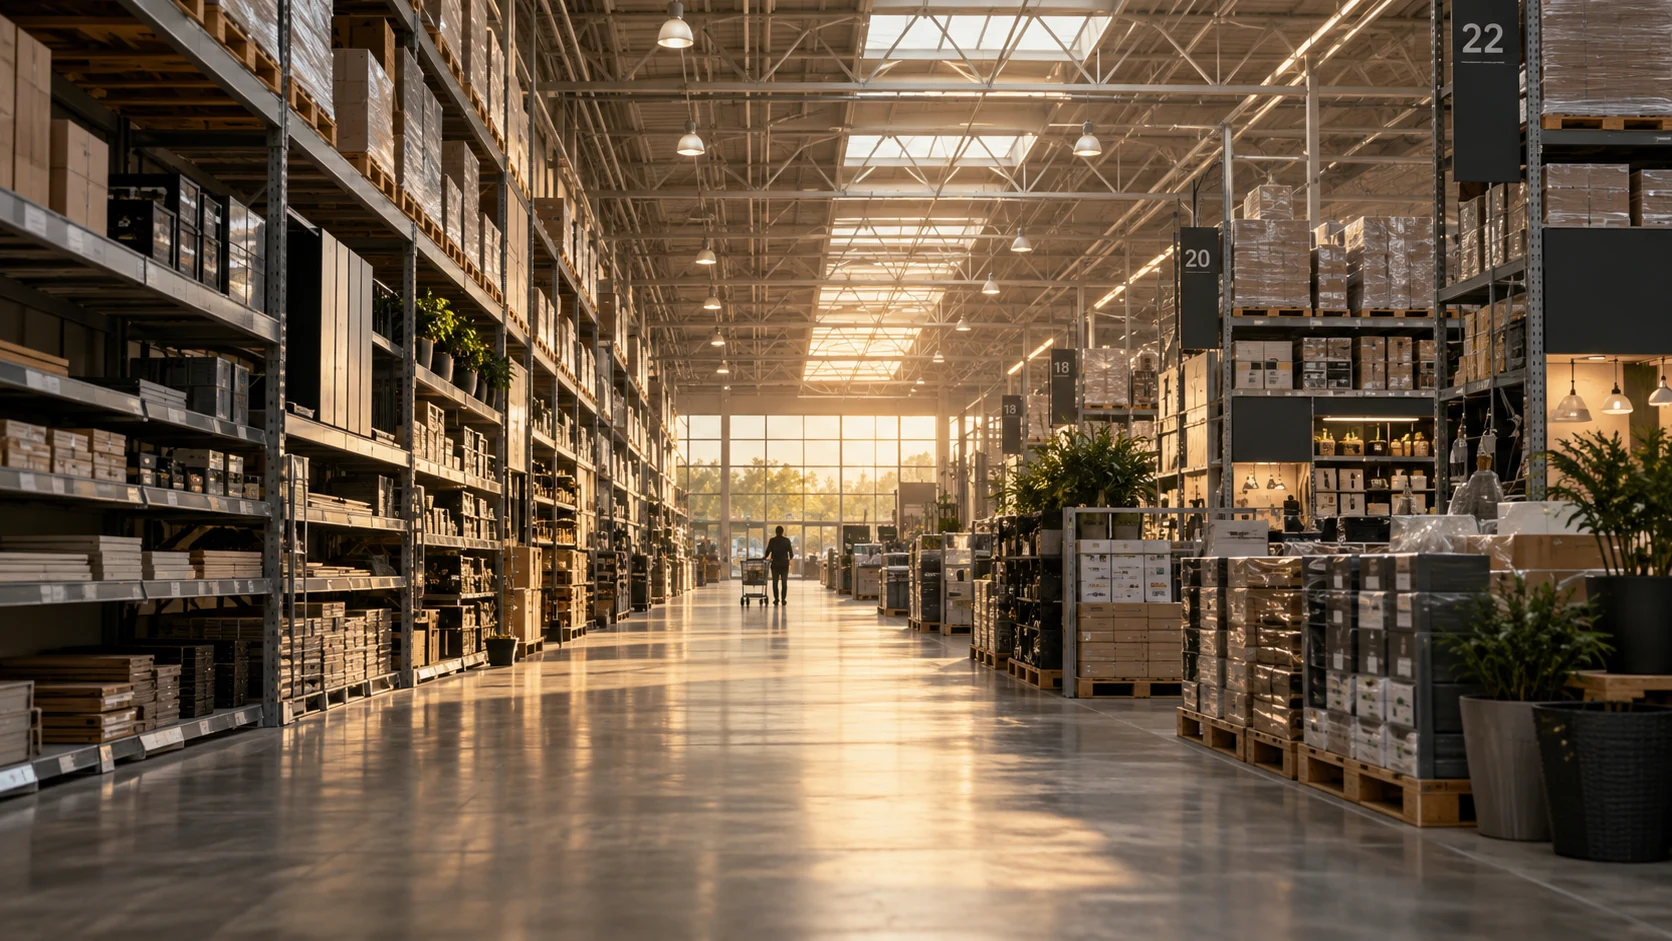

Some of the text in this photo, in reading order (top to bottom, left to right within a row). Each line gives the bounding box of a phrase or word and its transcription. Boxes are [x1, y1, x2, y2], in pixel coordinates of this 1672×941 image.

[1462, 23, 1504, 53] 22
[1185, 249, 1210, 268] 20
[1054, 361, 1069, 374] 18
